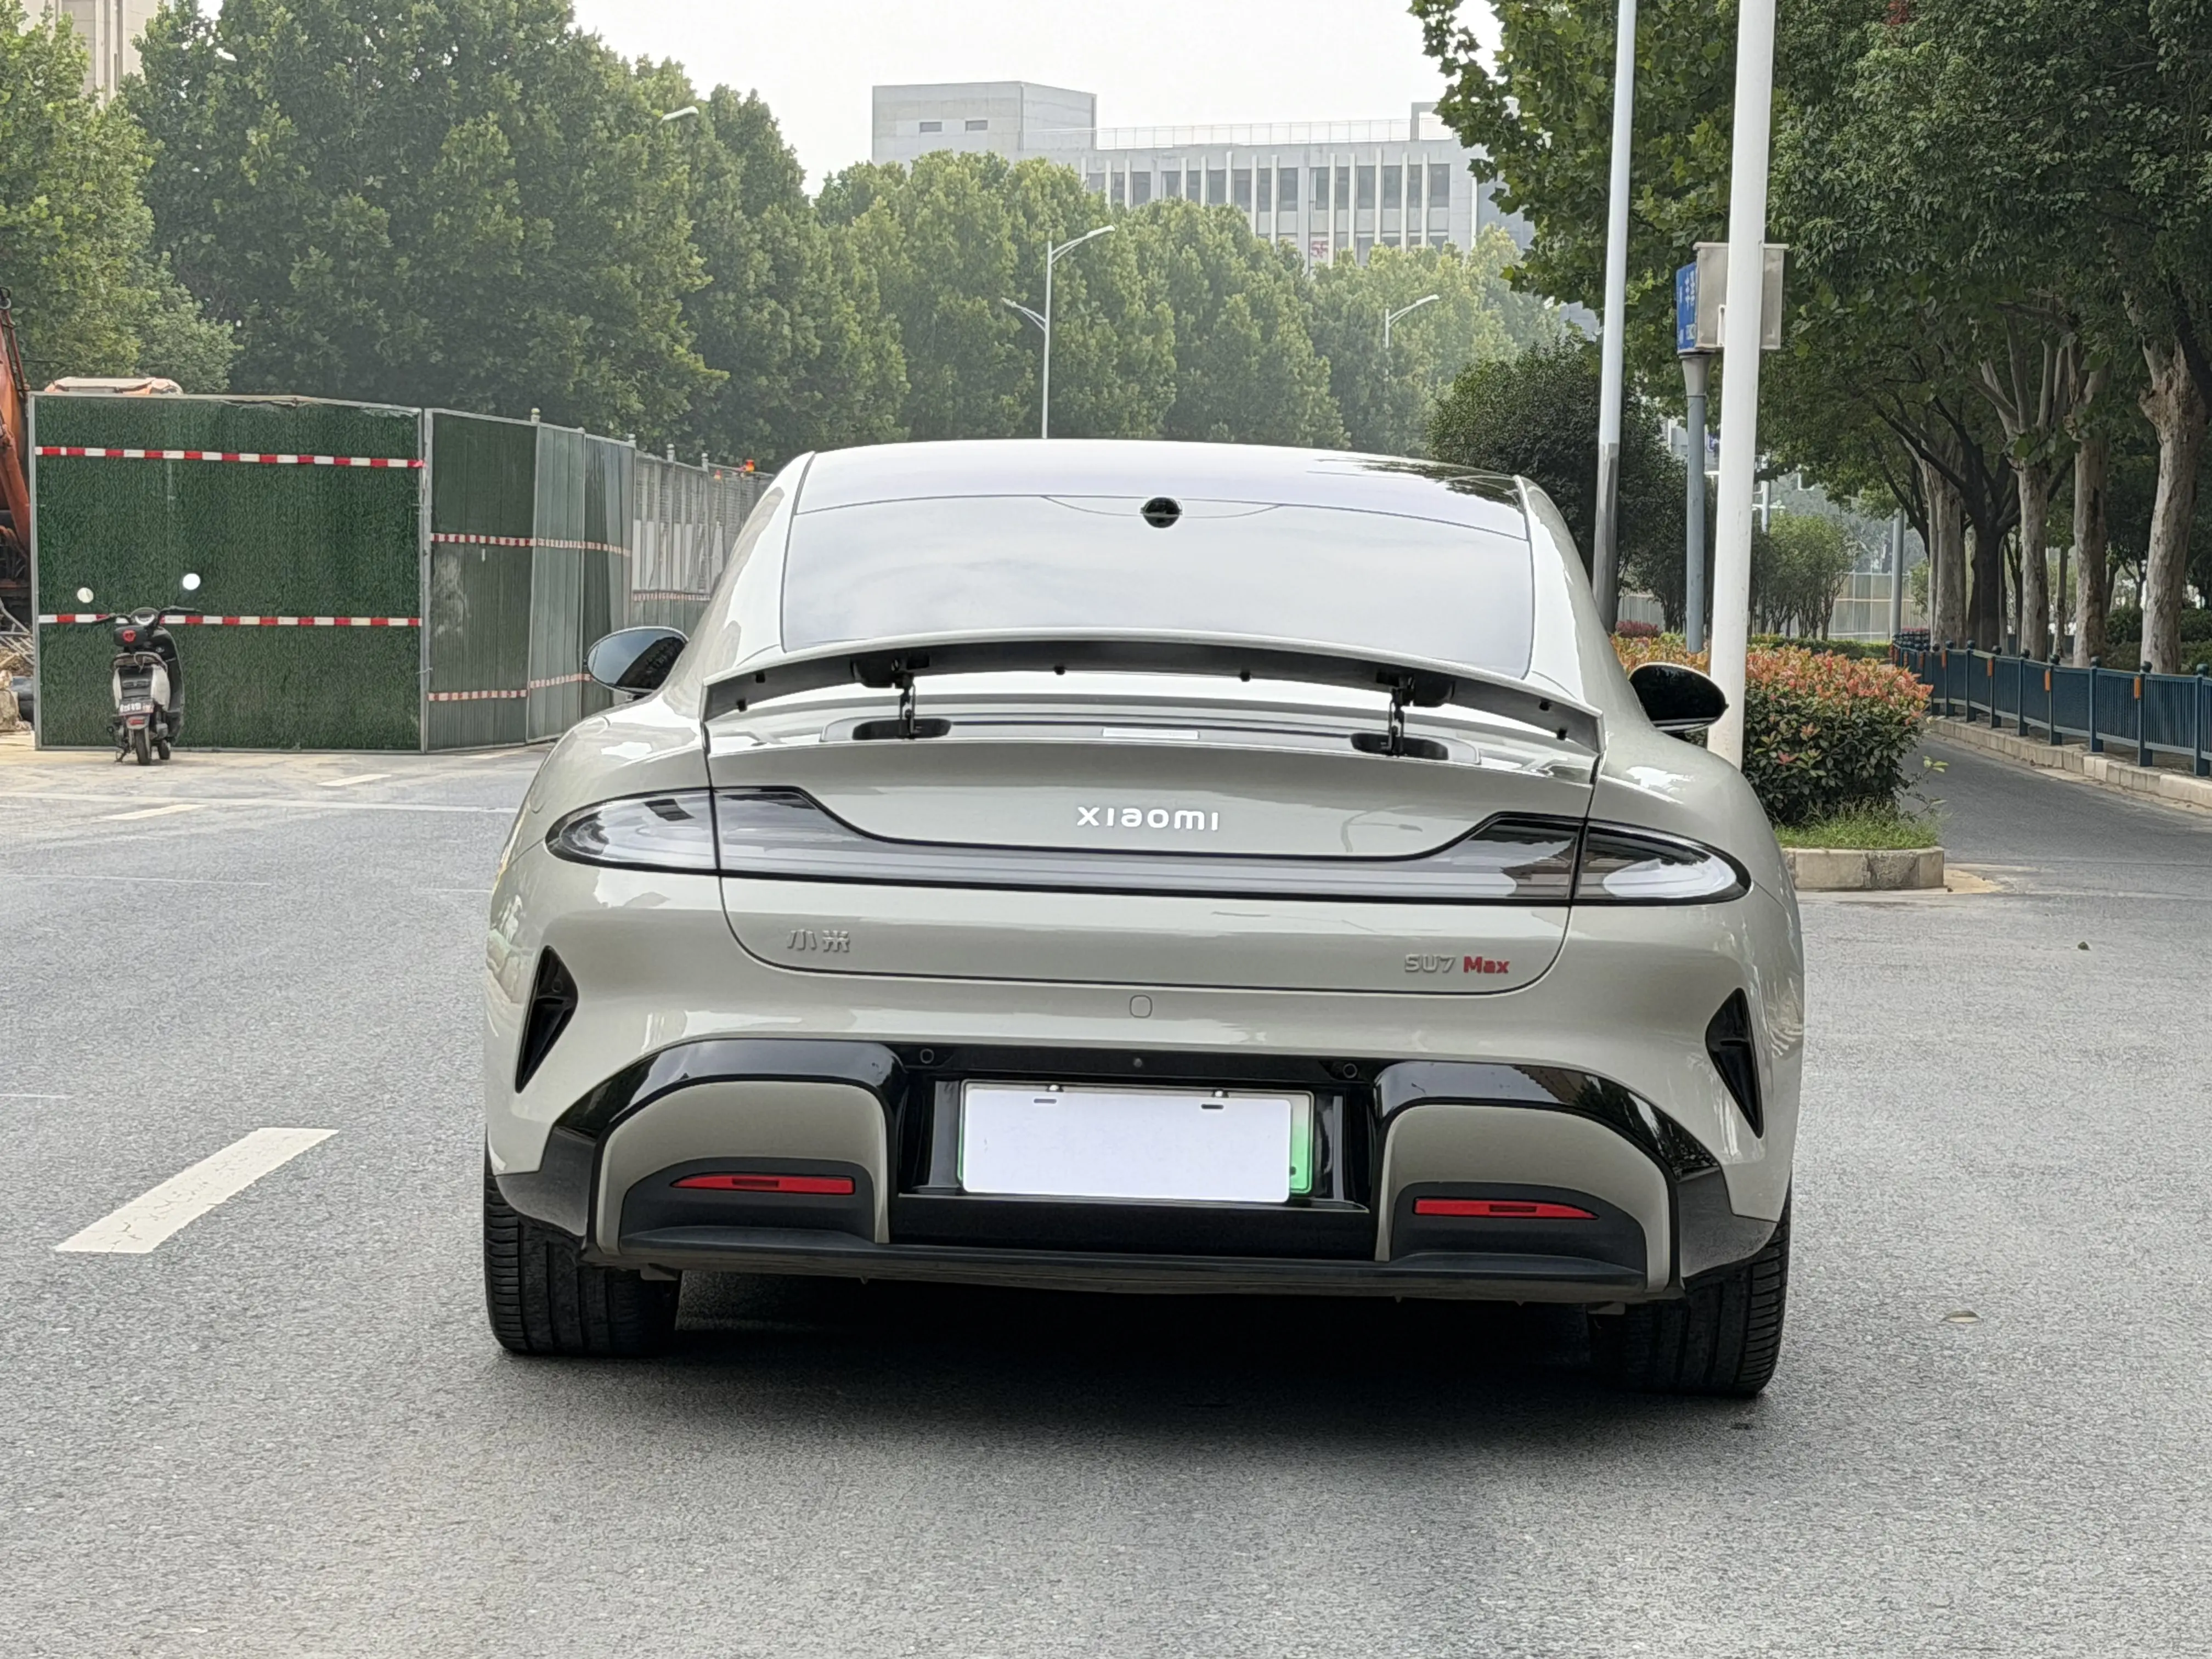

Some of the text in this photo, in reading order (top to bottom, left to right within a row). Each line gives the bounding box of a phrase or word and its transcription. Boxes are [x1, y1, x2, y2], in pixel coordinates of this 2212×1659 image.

[786, 928, 850, 953] 小米
[1404, 953, 1511, 974] SU7 Max
